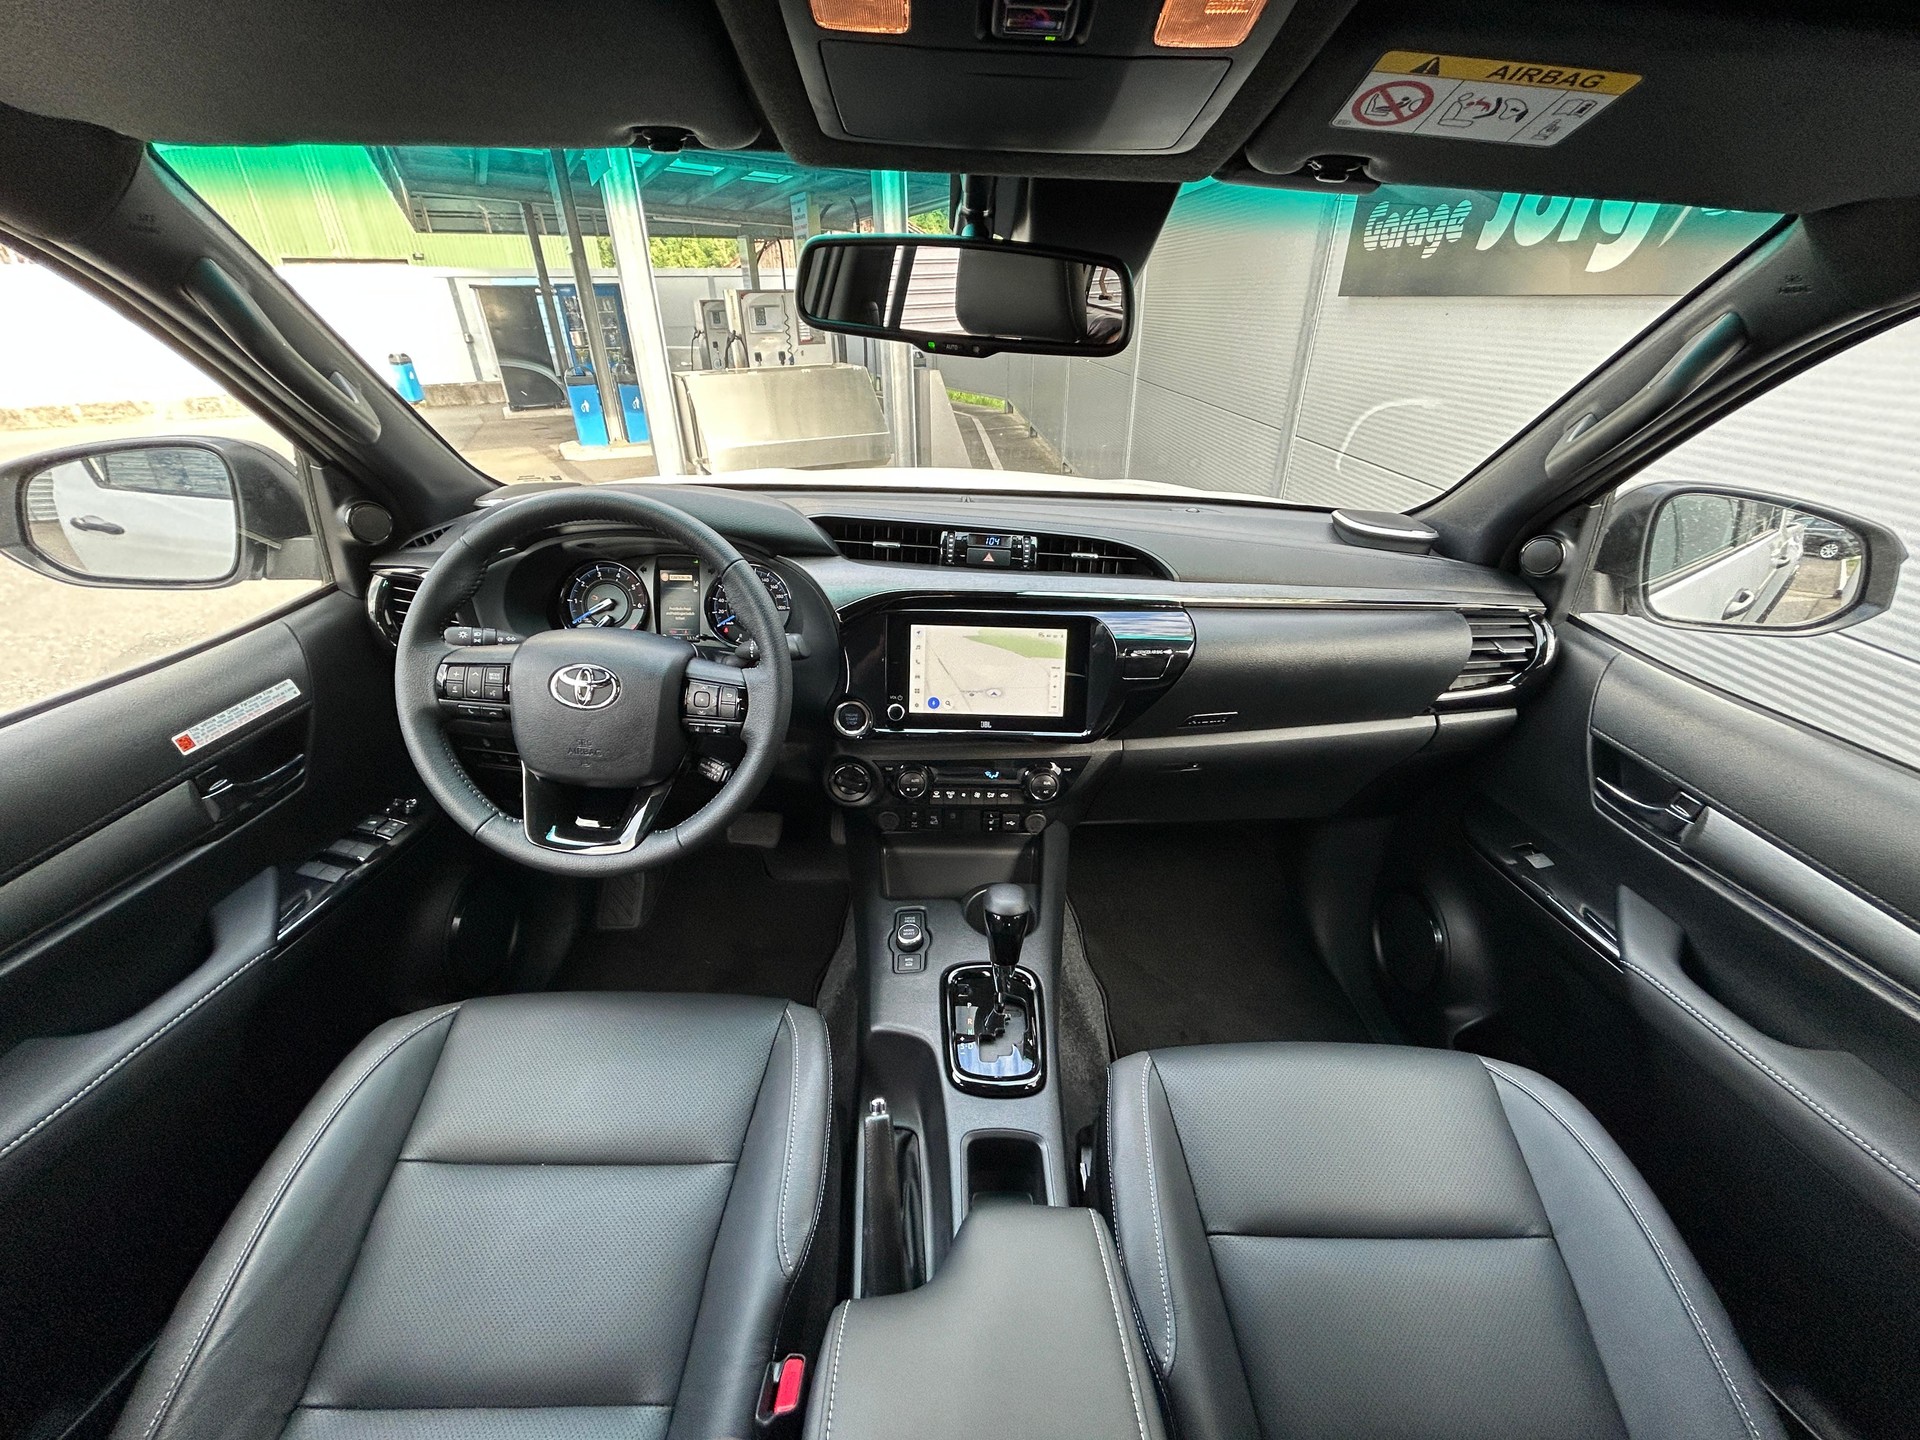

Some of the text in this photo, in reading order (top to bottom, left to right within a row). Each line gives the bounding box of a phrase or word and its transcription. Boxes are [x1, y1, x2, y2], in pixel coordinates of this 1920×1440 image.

[1485, 65, 1606, 90] AIRBAG
[1363, 199, 1473, 259] Garage
[985, 537, 1001, 546] 104
